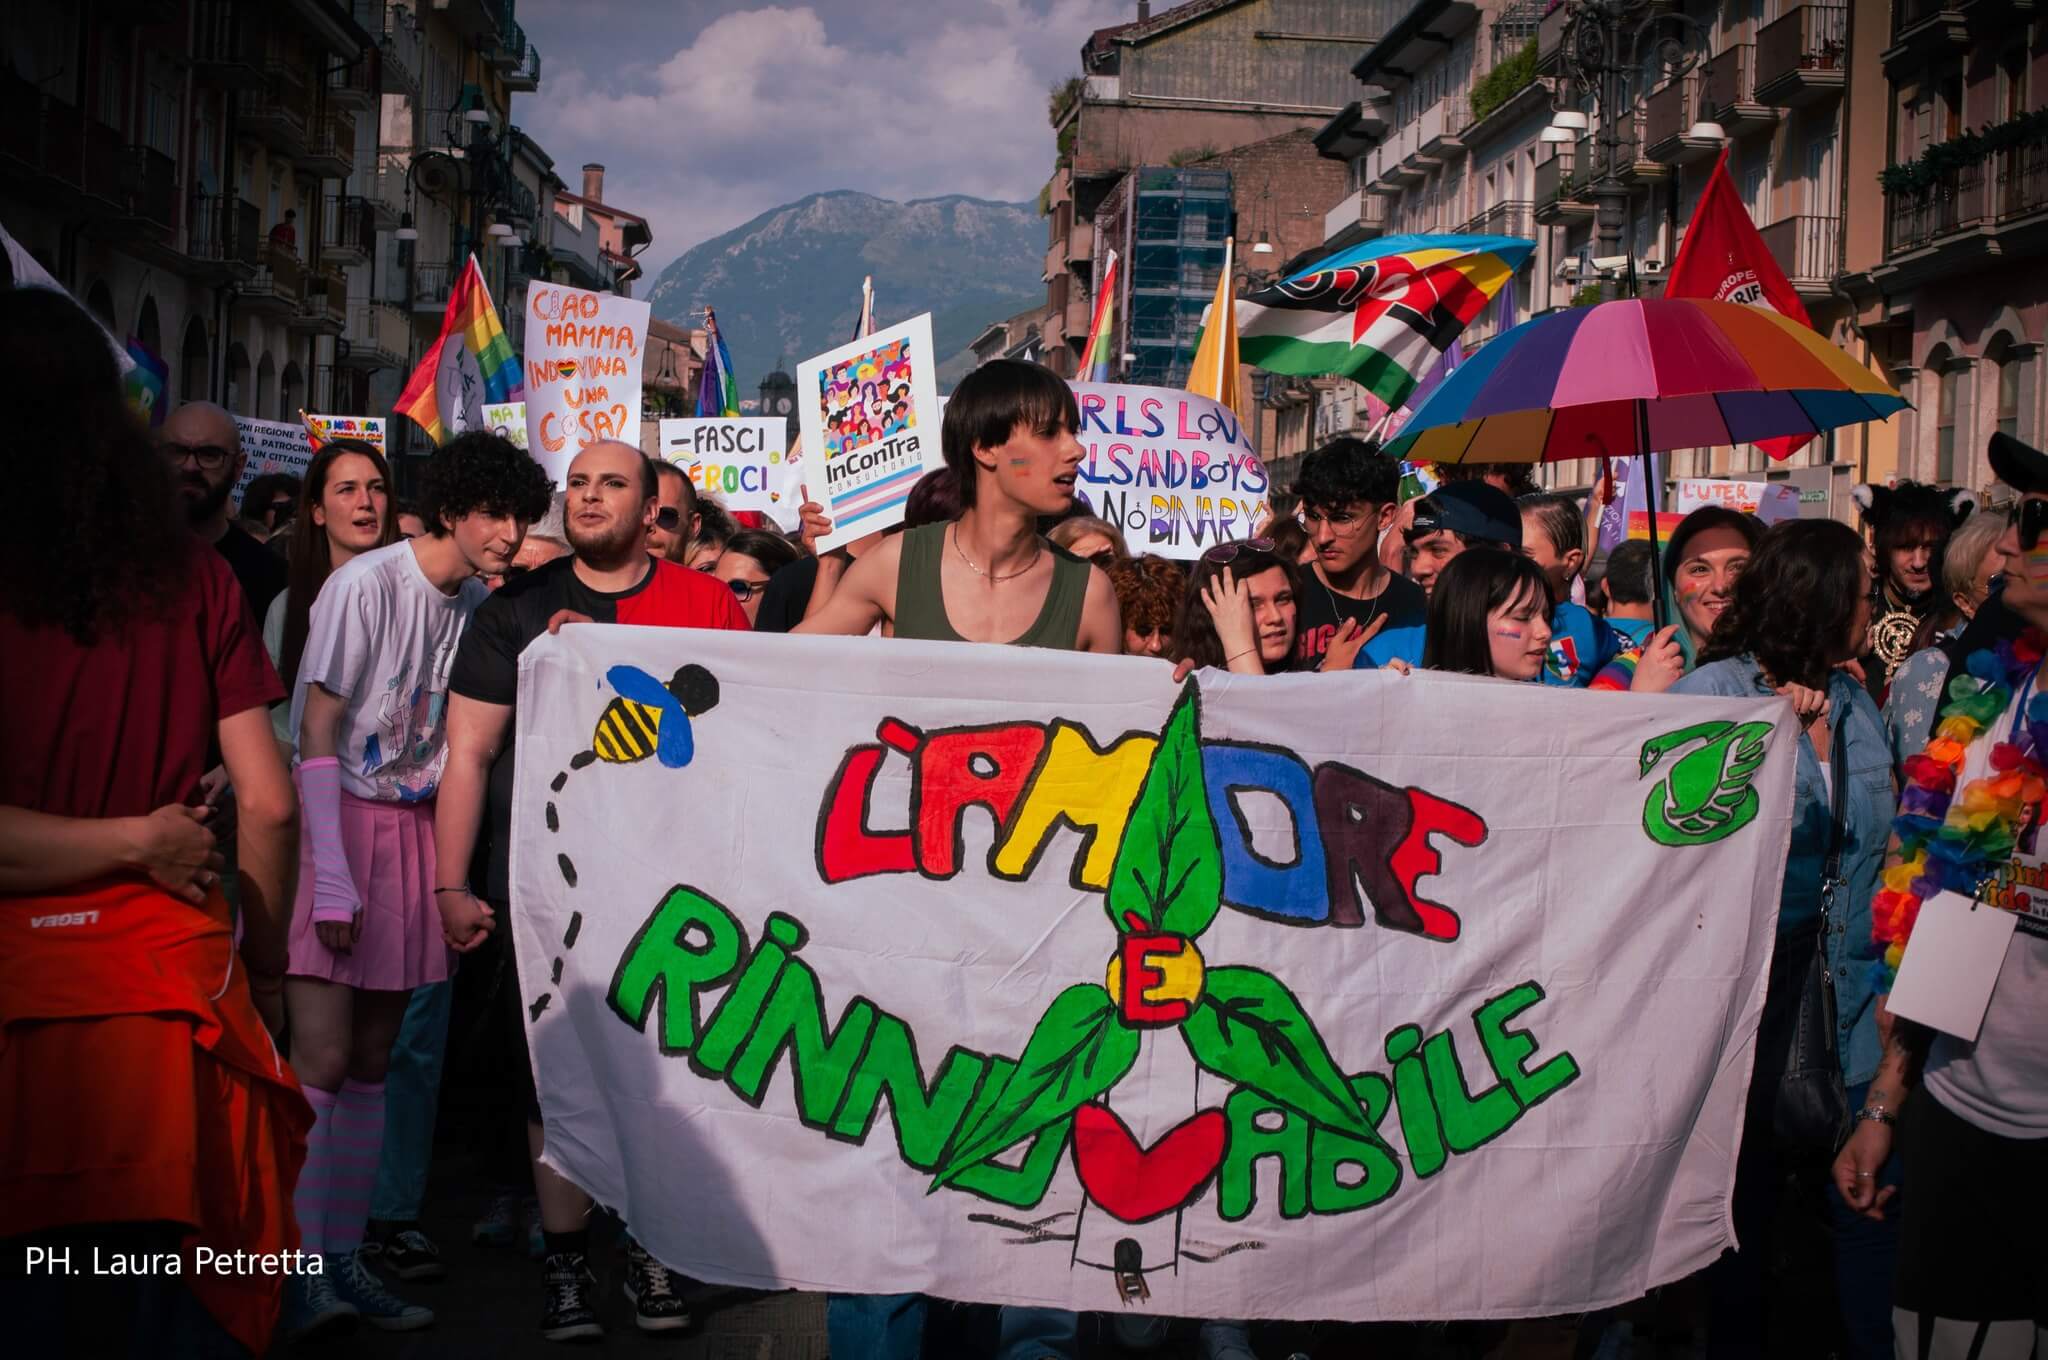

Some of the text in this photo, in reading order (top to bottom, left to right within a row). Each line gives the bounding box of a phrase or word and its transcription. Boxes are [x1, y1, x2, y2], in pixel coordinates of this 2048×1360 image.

[546, 321, 638, 357] MAMMA,
[563, 386, 609, 409] UNA
[237, 422, 253, 433] GNI
[254, 425, 295, 439] REGIONE
[252, 450, 266, 459] UN
[268, 452, 311, 467] CITTADIN
[826, 434, 920, 484] InConTra
[828, 451, 923, 497] CONSULTORIO
[815, 715, 1490, 943] L'AMORE
[31, 910, 101, 930] LEGEA
